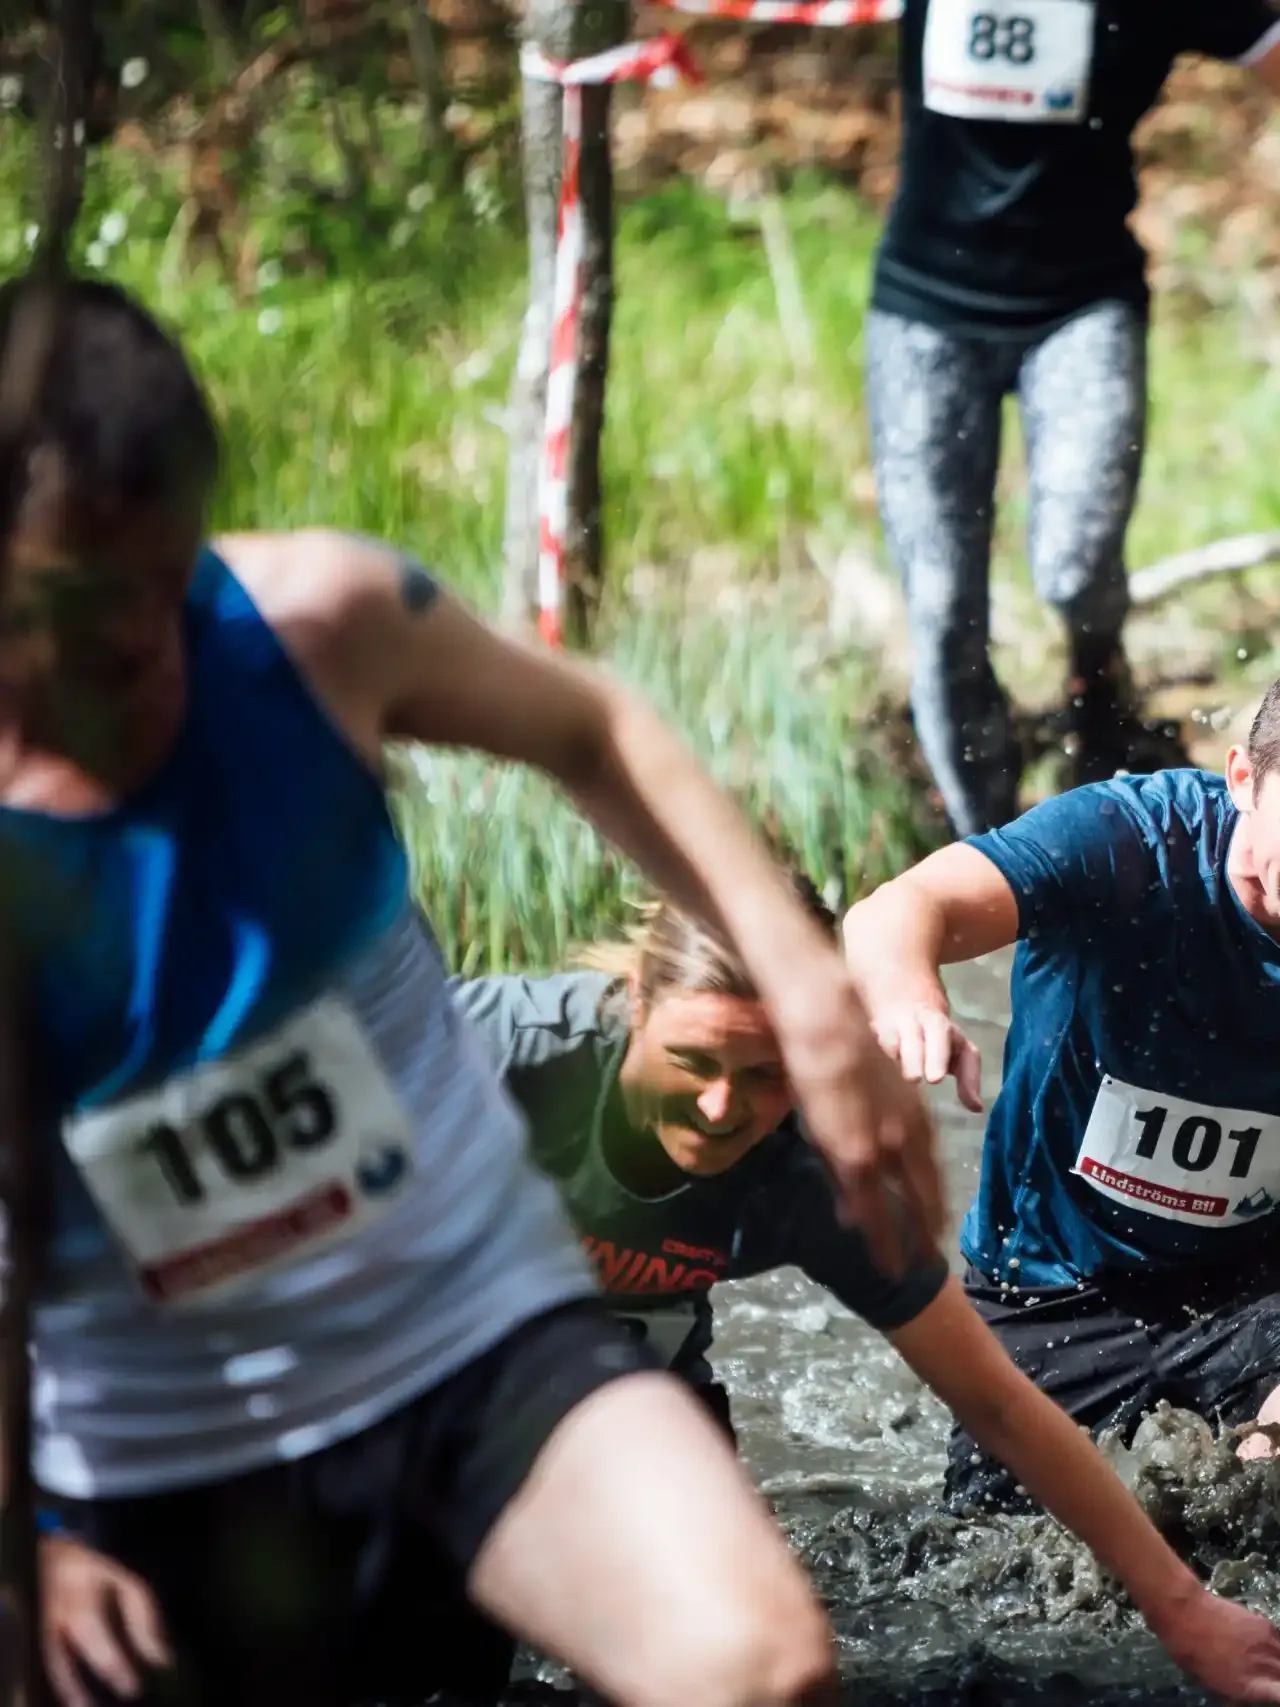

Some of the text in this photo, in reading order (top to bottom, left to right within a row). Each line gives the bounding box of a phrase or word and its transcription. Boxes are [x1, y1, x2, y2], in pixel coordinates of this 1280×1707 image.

[970, 14, 1034, 64] 88
[131, 1049, 336, 1208] 105
[1134, 1106, 1262, 1178] 101
[1091, 1165, 1187, 1208] Lindströms
